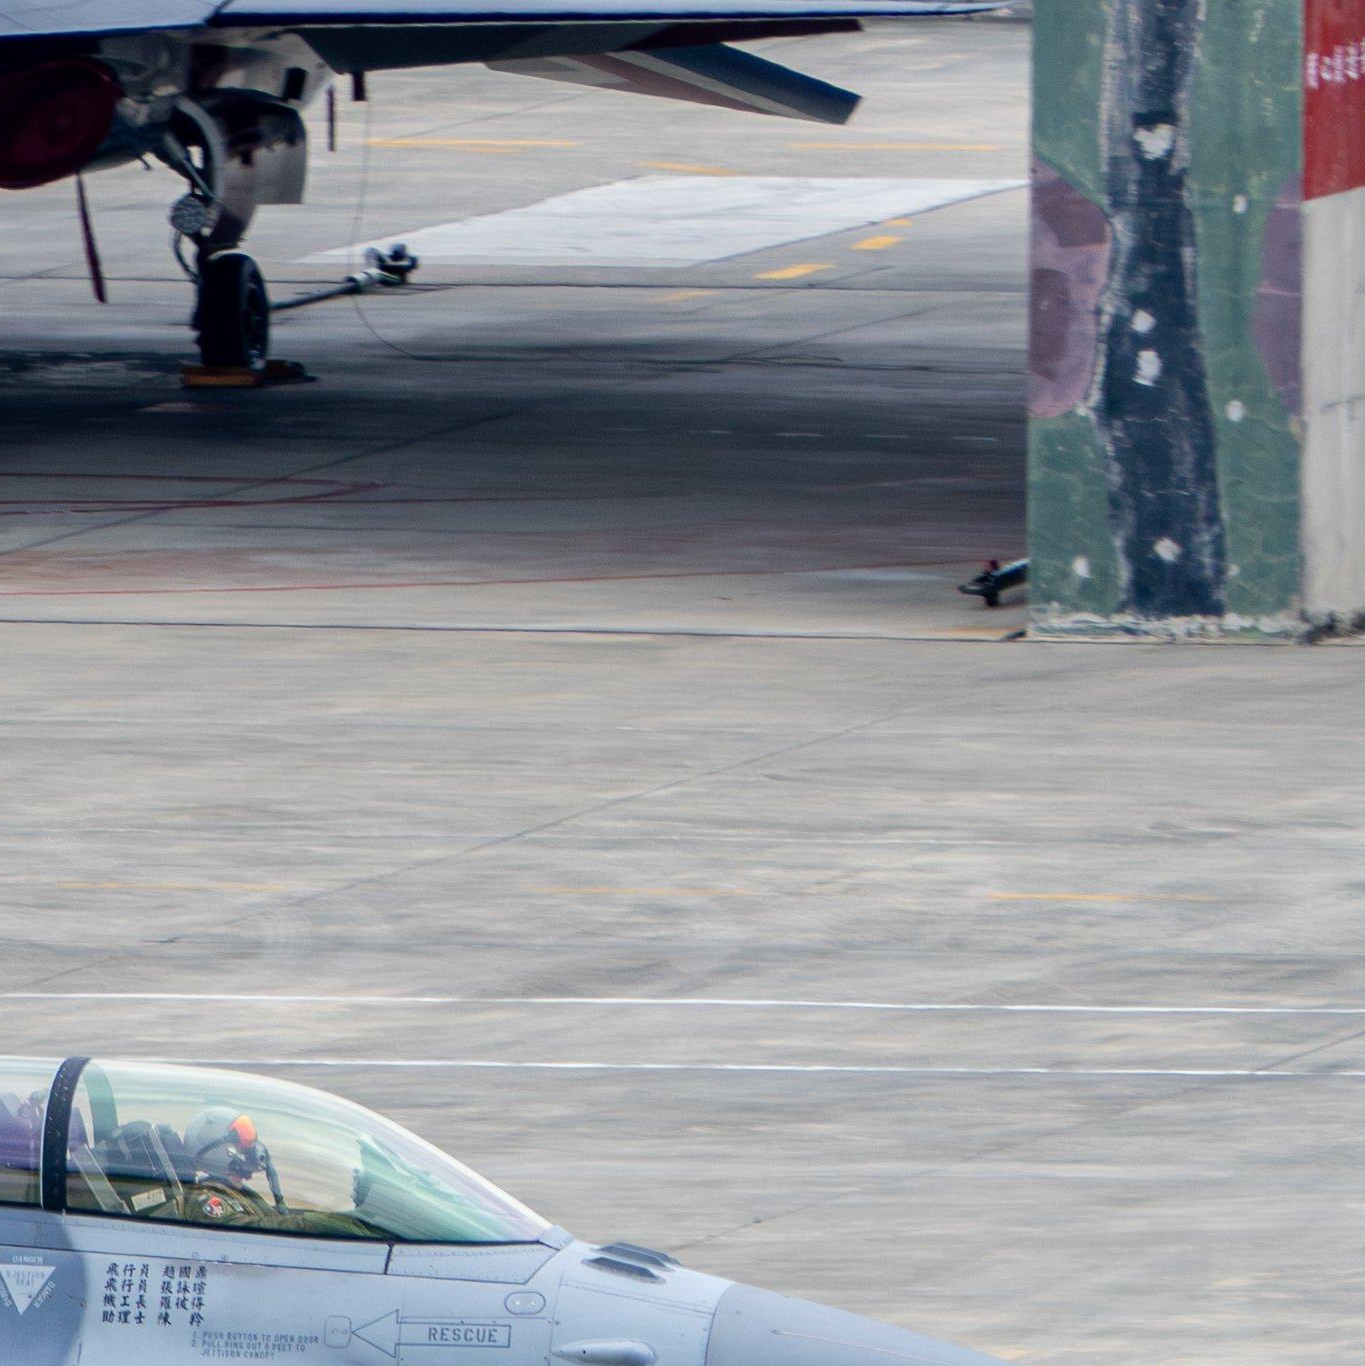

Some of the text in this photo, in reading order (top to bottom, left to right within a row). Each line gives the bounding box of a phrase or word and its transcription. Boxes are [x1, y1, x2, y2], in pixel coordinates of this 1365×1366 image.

[106, 1262, 149, 1279] 飛行員
[104, 1277, 147, 1294] 飛行員
[102, 1293, 147, 1309] 機工長
[102, 1309, 146, 1325] 助理士
[203, 1331, 224, 1340] PUSH
[227, 1332, 259, 1342] BUTTON
[274, 1335, 295, 1343] OPEN
[298, 1336, 319, 1344] DOOR
[428, 1326, 498, 1344] RESCUE
